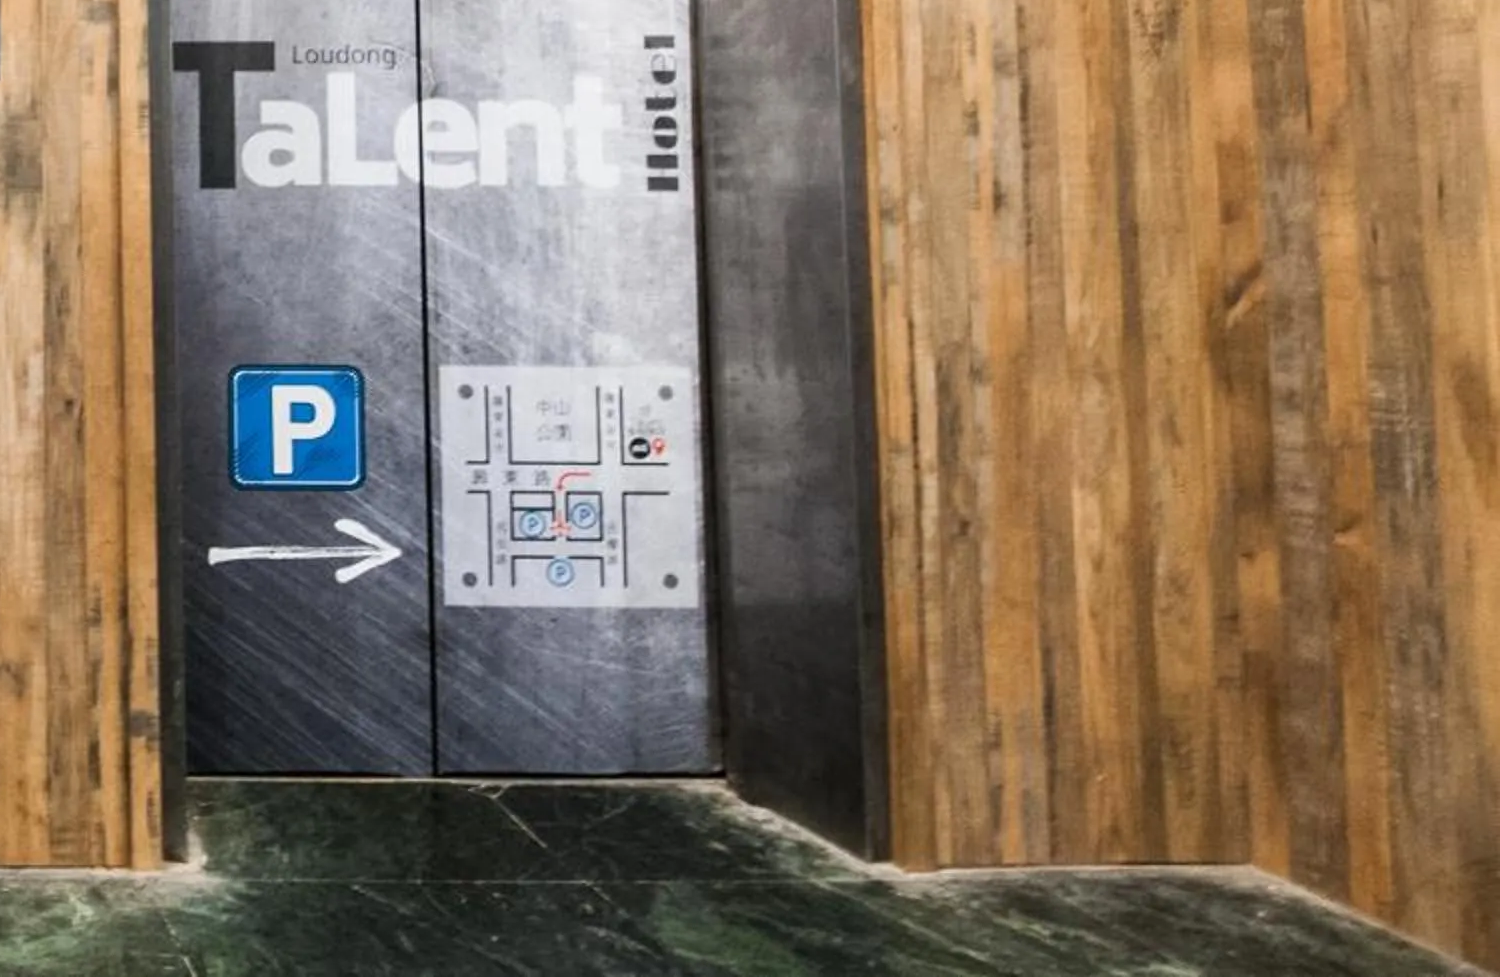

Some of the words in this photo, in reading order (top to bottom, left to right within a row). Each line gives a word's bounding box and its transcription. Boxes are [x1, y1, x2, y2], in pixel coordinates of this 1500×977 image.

[173, 41, 623, 190] TaLent
[291, 43, 398, 70] Loudong
[643, 35, 680, 192] Hotel
[271, 384, 337, 476] P
